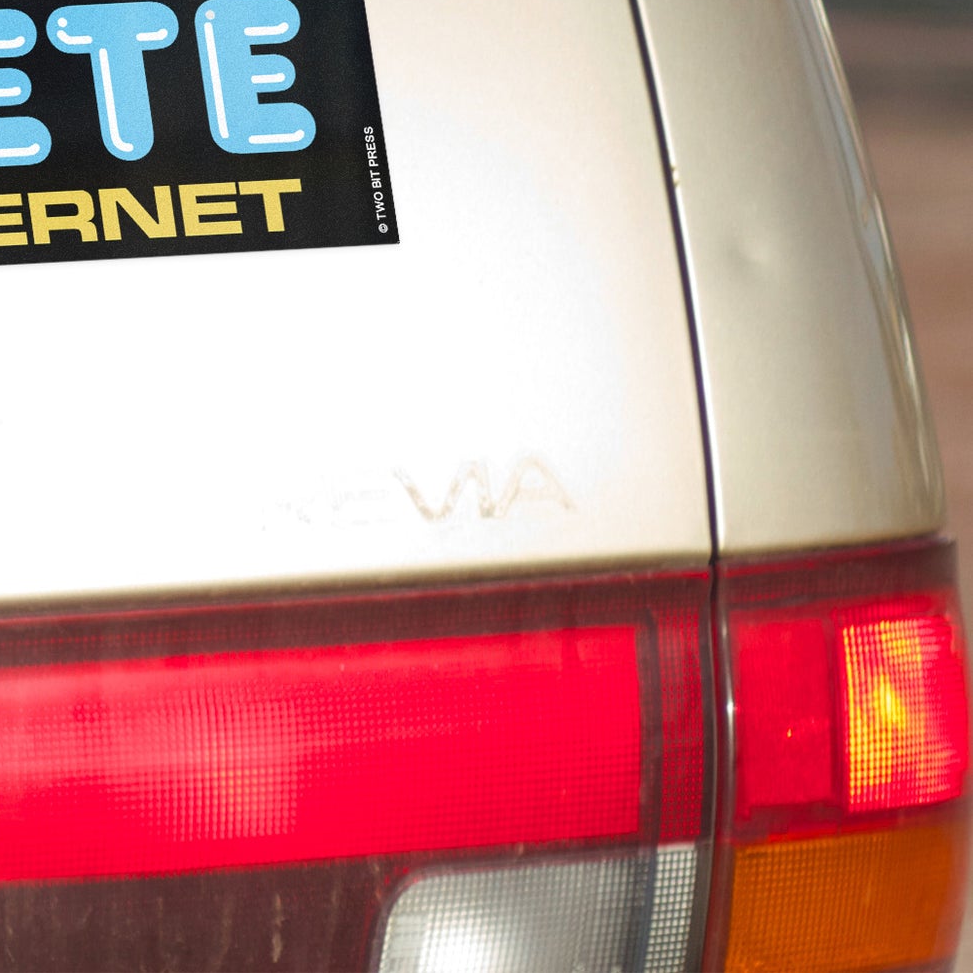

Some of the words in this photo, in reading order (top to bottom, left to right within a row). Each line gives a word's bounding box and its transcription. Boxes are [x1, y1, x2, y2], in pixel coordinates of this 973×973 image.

[363, 126, 379, 167] PRESS
[369, 169, 382, 188] BIT
[373, 191, 387, 220] TWO
